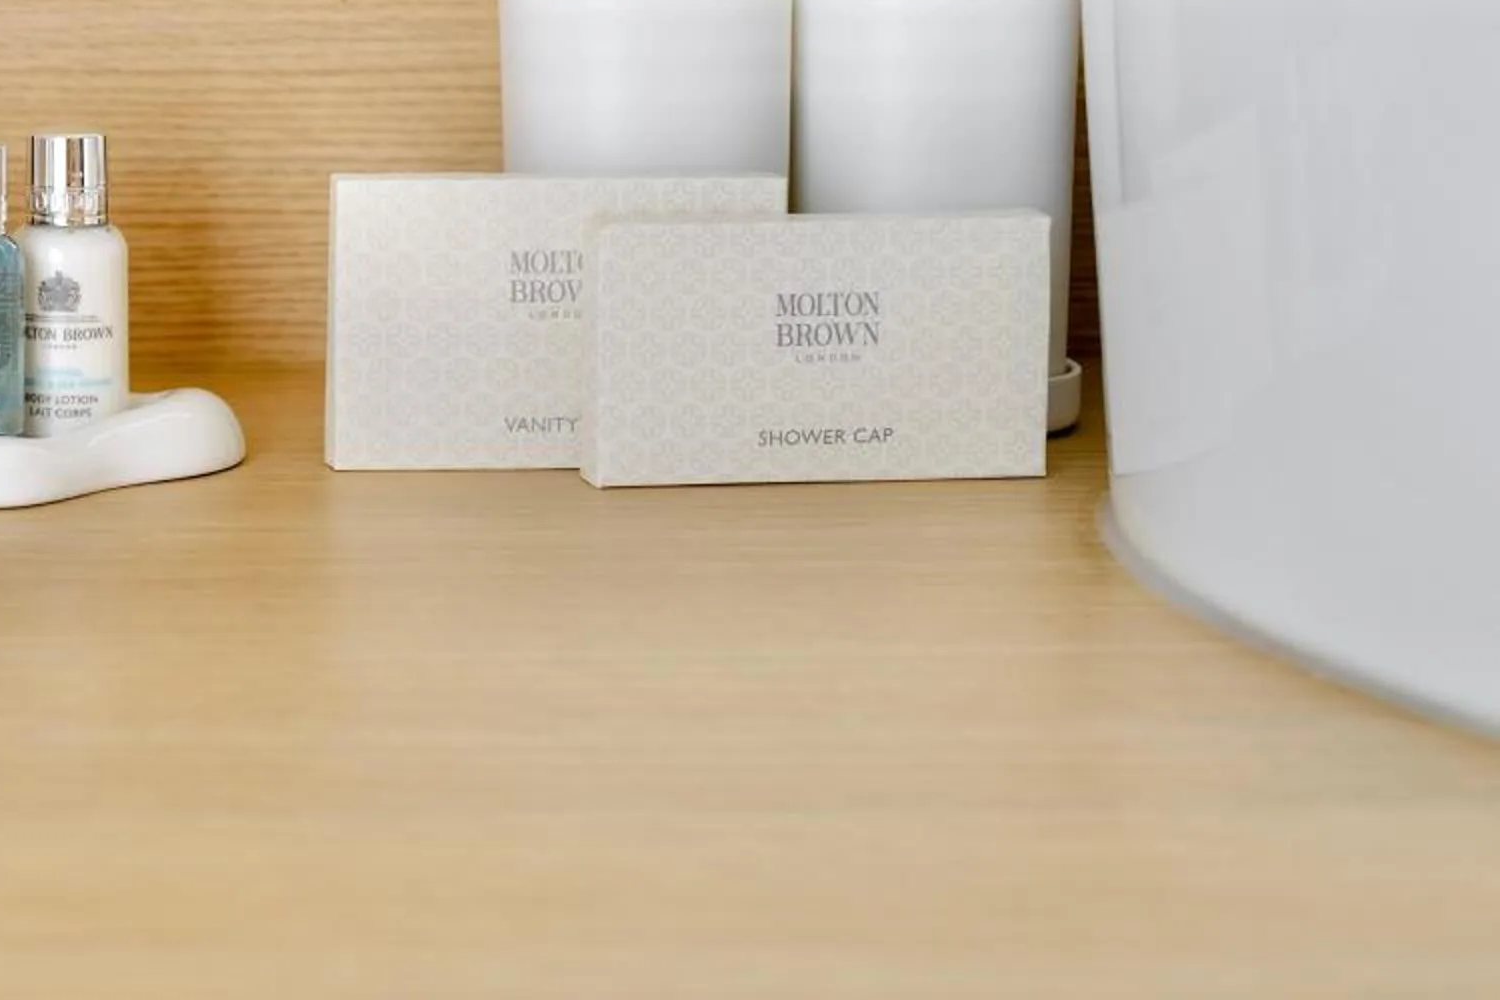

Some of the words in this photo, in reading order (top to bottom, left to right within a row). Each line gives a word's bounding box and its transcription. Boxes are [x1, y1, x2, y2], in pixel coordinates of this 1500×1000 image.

[776, 290, 880, 317] MOLTON
[62, 326, 114, 342] BROWN
[776, 321, 880, 348] BROWN
[54, 394, 99, 406] LOTION
[504, 416, 579, 434] VANITY
[758, 428, 846, 448] SHOWER
[853, 426, 894, 445] CAP
